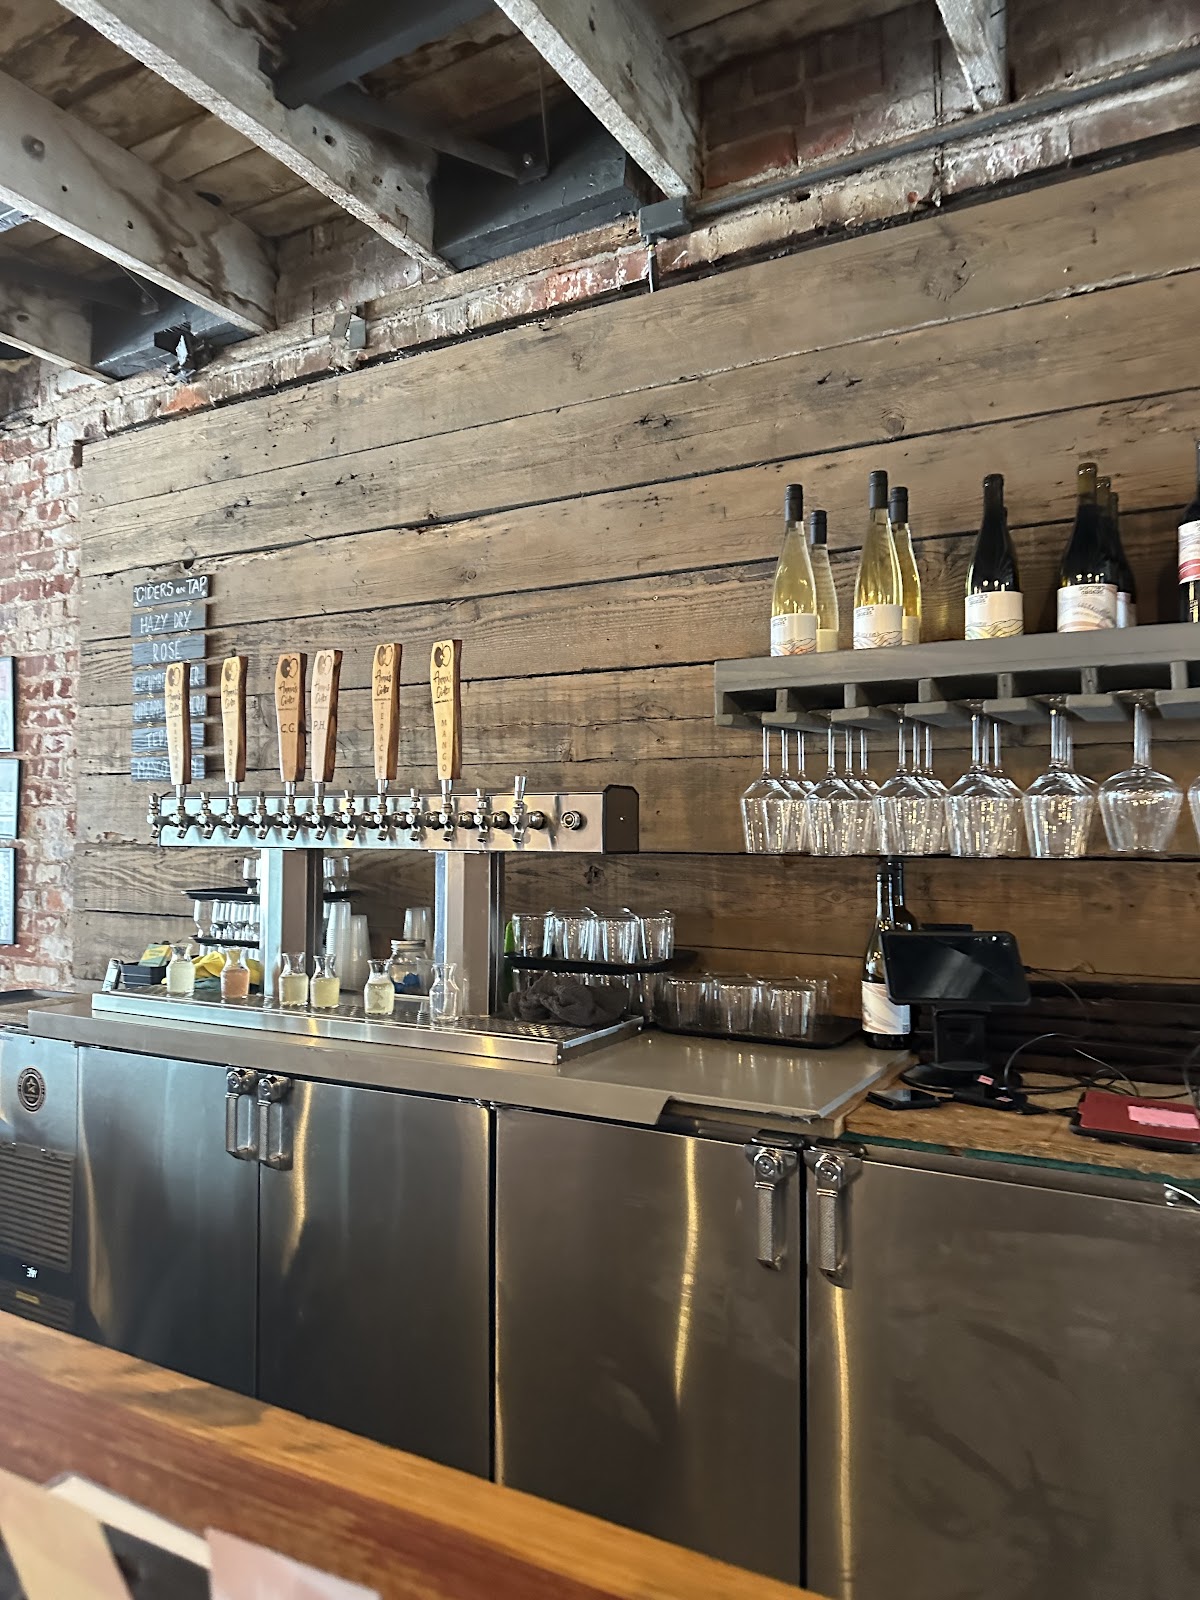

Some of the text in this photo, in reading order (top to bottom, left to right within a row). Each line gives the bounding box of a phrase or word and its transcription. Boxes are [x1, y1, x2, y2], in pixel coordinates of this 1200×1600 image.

[135, 581, 174, 602] CIDERS
[186, 575, 207, 594] TAP
[140, 610, 192, 634] HAZY DRY
[280, 723, 297, 734] C.G.
